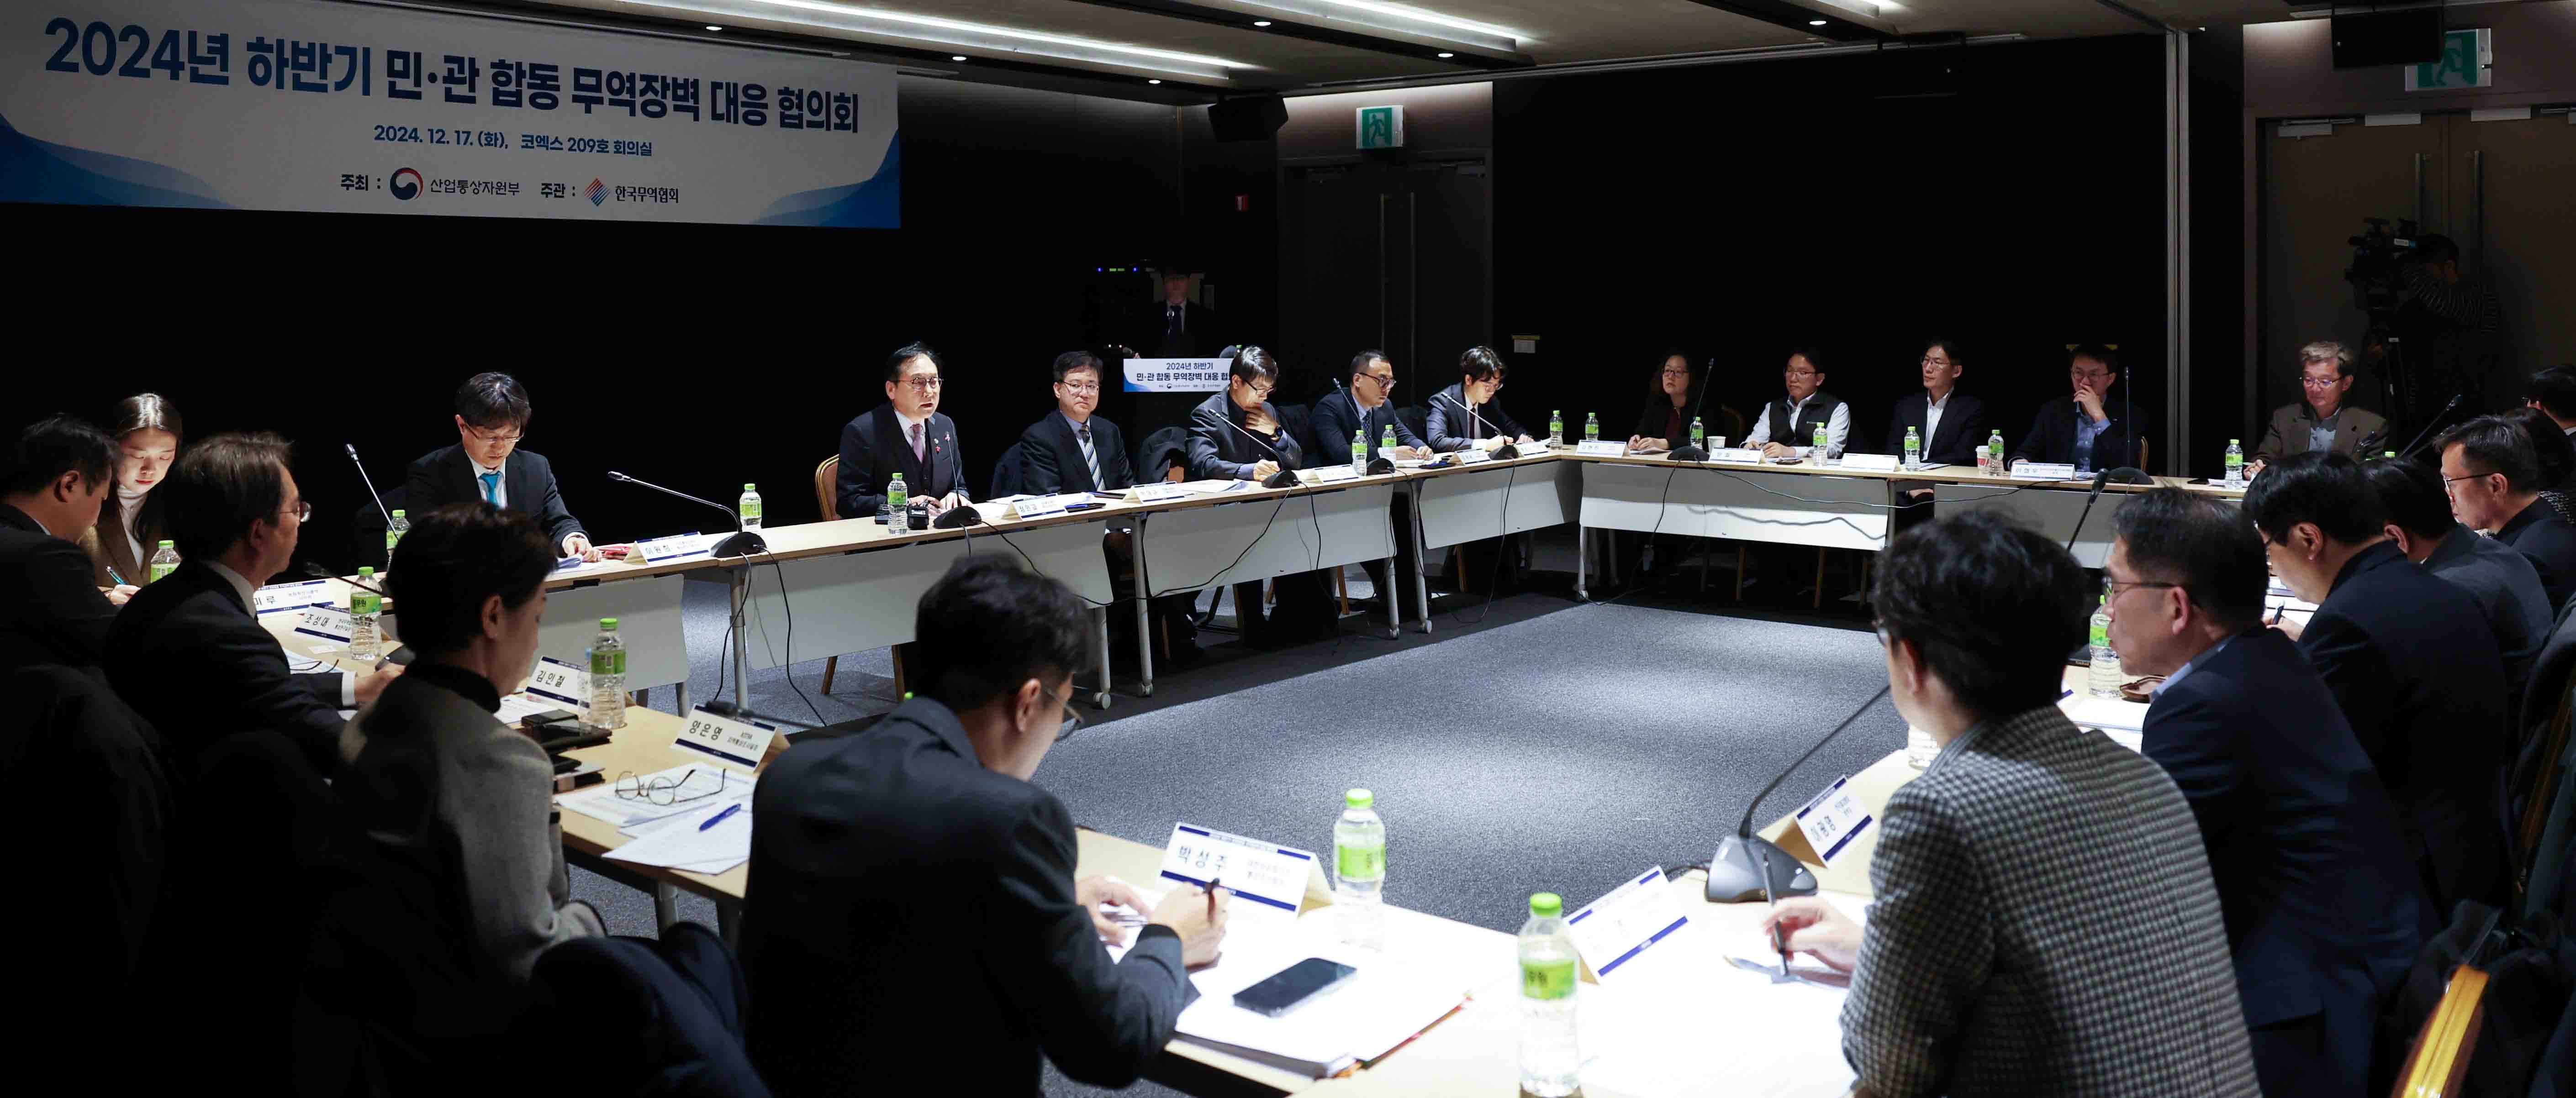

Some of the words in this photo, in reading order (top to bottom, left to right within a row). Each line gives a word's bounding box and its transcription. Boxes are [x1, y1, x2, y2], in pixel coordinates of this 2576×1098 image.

[45, 17, 229, 85] 2024년
[247, 37, 370, 96] 하반기
[387, 50, 480, 104] 민·관
[490, 59, 560, 110] 합동
[572, 67, 700, 122] 무역장벽
[711, 81, 769, 126] 대응
[777, 86, 858, 133] 협의회
[374, 125, 423, 143] 2024.
[428, 128, 450, 145] 12.
[454, 130, 474, 146] 17.
[478, 131, 508, 149] (화),
[521, 134, 563, 150] 코엑스
[568, 137, 609, 154] 209호
[613, 139, 652, 157] 회의실
[341, 174, 369, 191] 주최
[431, 179, 520, 196] 산업통상자원부
[541, 182, 566, 199] 주관
[615, 185, 679, 204] 한국무역협회
[1156, 373, 1171, 381] 합동
[1173, 373, 1203, 381] 무역장벽
[1204, 373, 1219, 381] 대응
